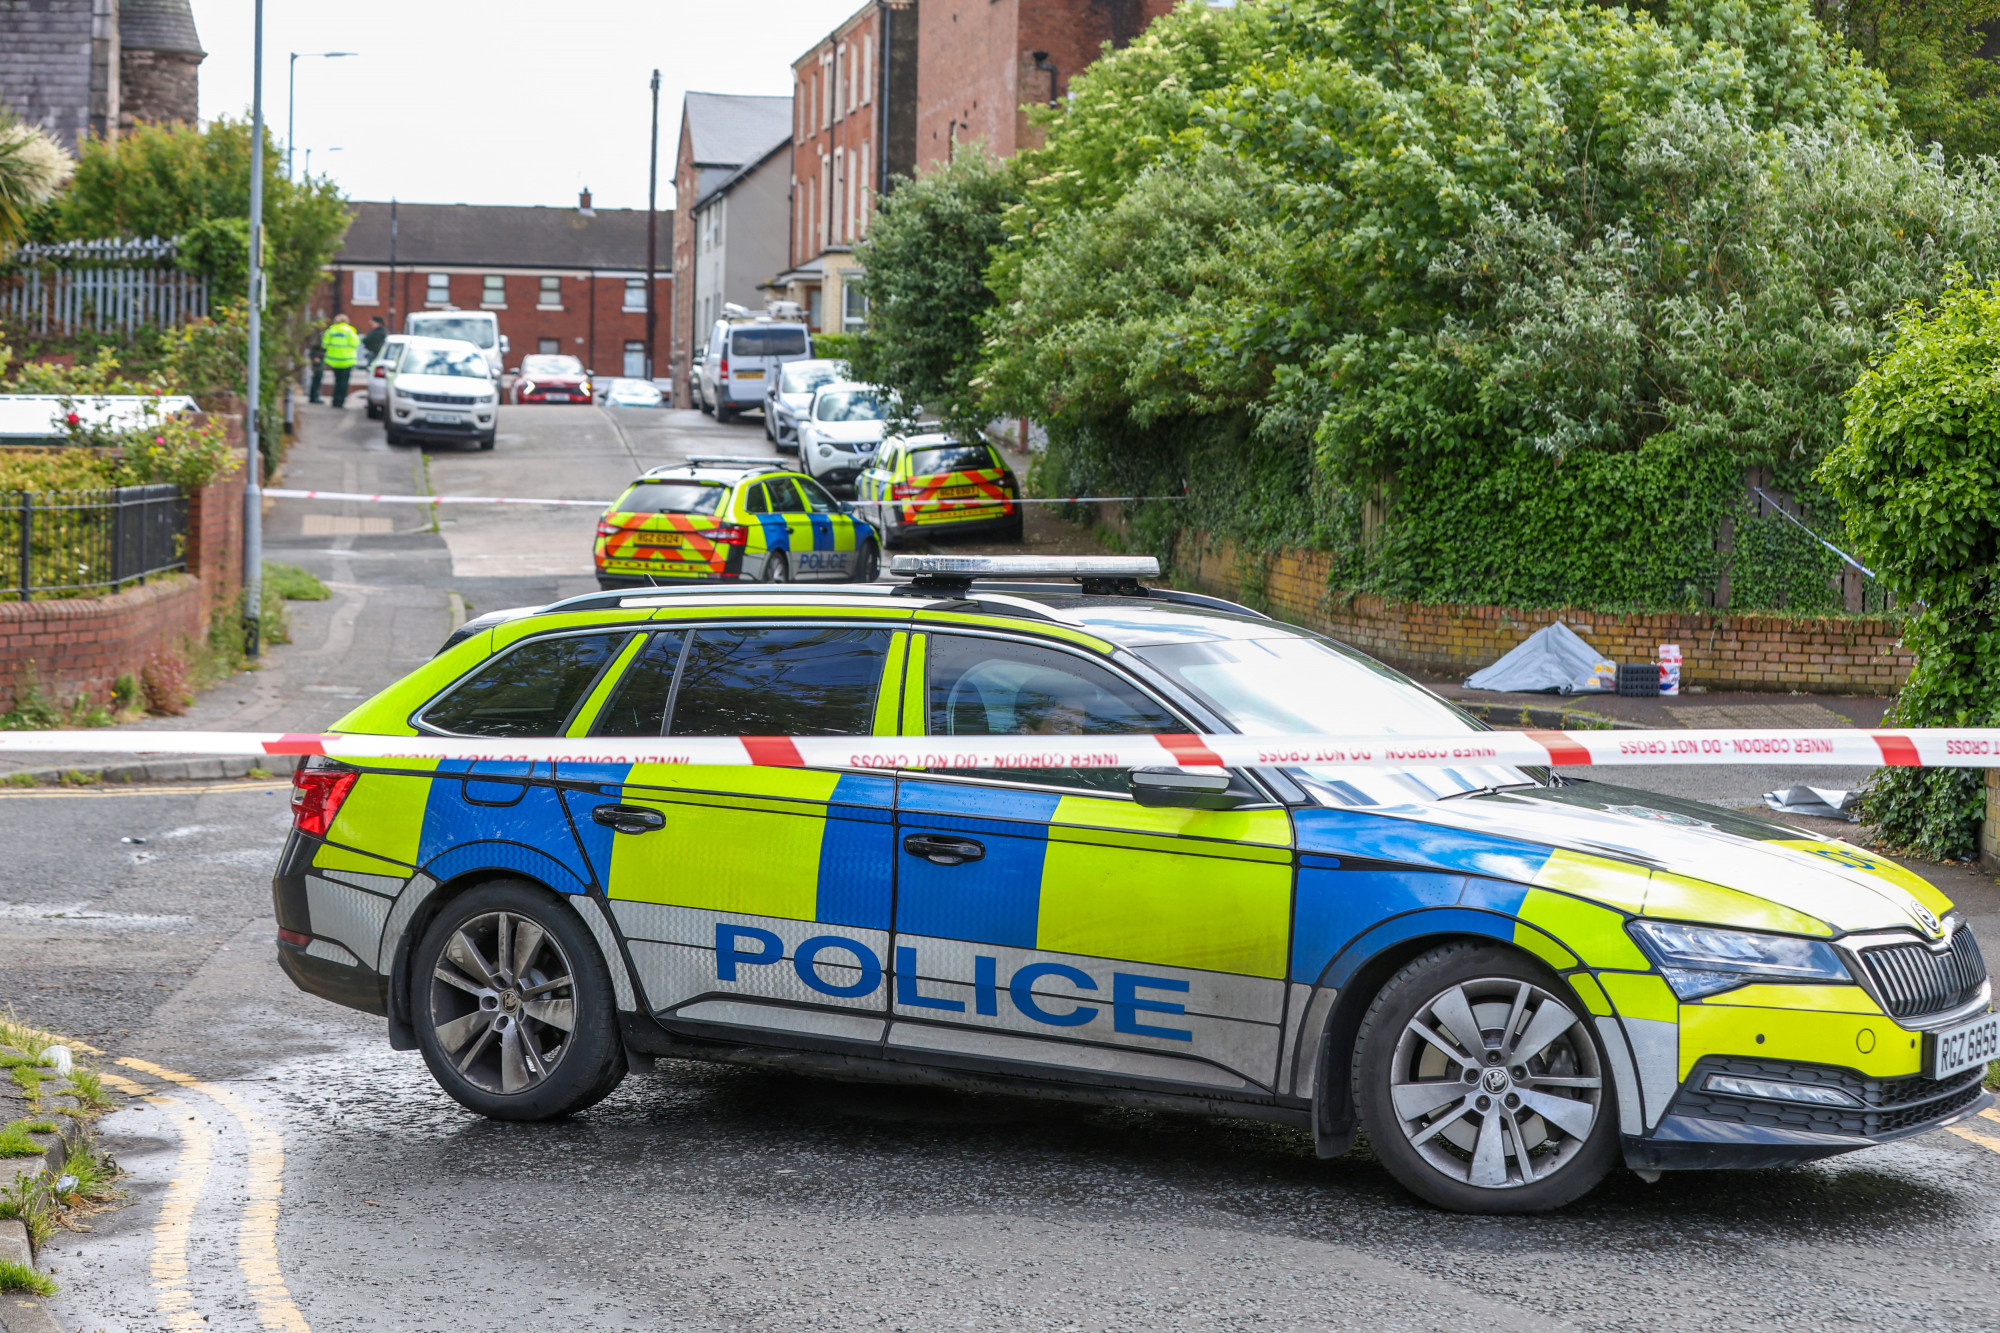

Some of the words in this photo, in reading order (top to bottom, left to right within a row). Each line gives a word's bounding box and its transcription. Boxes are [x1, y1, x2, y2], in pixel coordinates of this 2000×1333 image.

[929, 508, 990, 519] POLICE
[608, 560, 704, 572] POLICE
[799, 554, 847, 569] POLICE
[1619, 740, 1668, 755] CROSS
[1671, 739, 1699, 754] NOT
[1702, 739, 1722, 754] DO
[1733, 738, 1790, 754] CORDON
[1794, 738, 1834, 753] INNER
[1946, 740, 1990, 755] CROSS
[849, 754, 909, 768] CROSS
[1069, 752, 1119, 768] INNER
[715, 922, 1193, 1042] POLICE
[1941, 1032, 1965, 1073] RGZ
[1968, 1020, 1997, 1062] 6858
